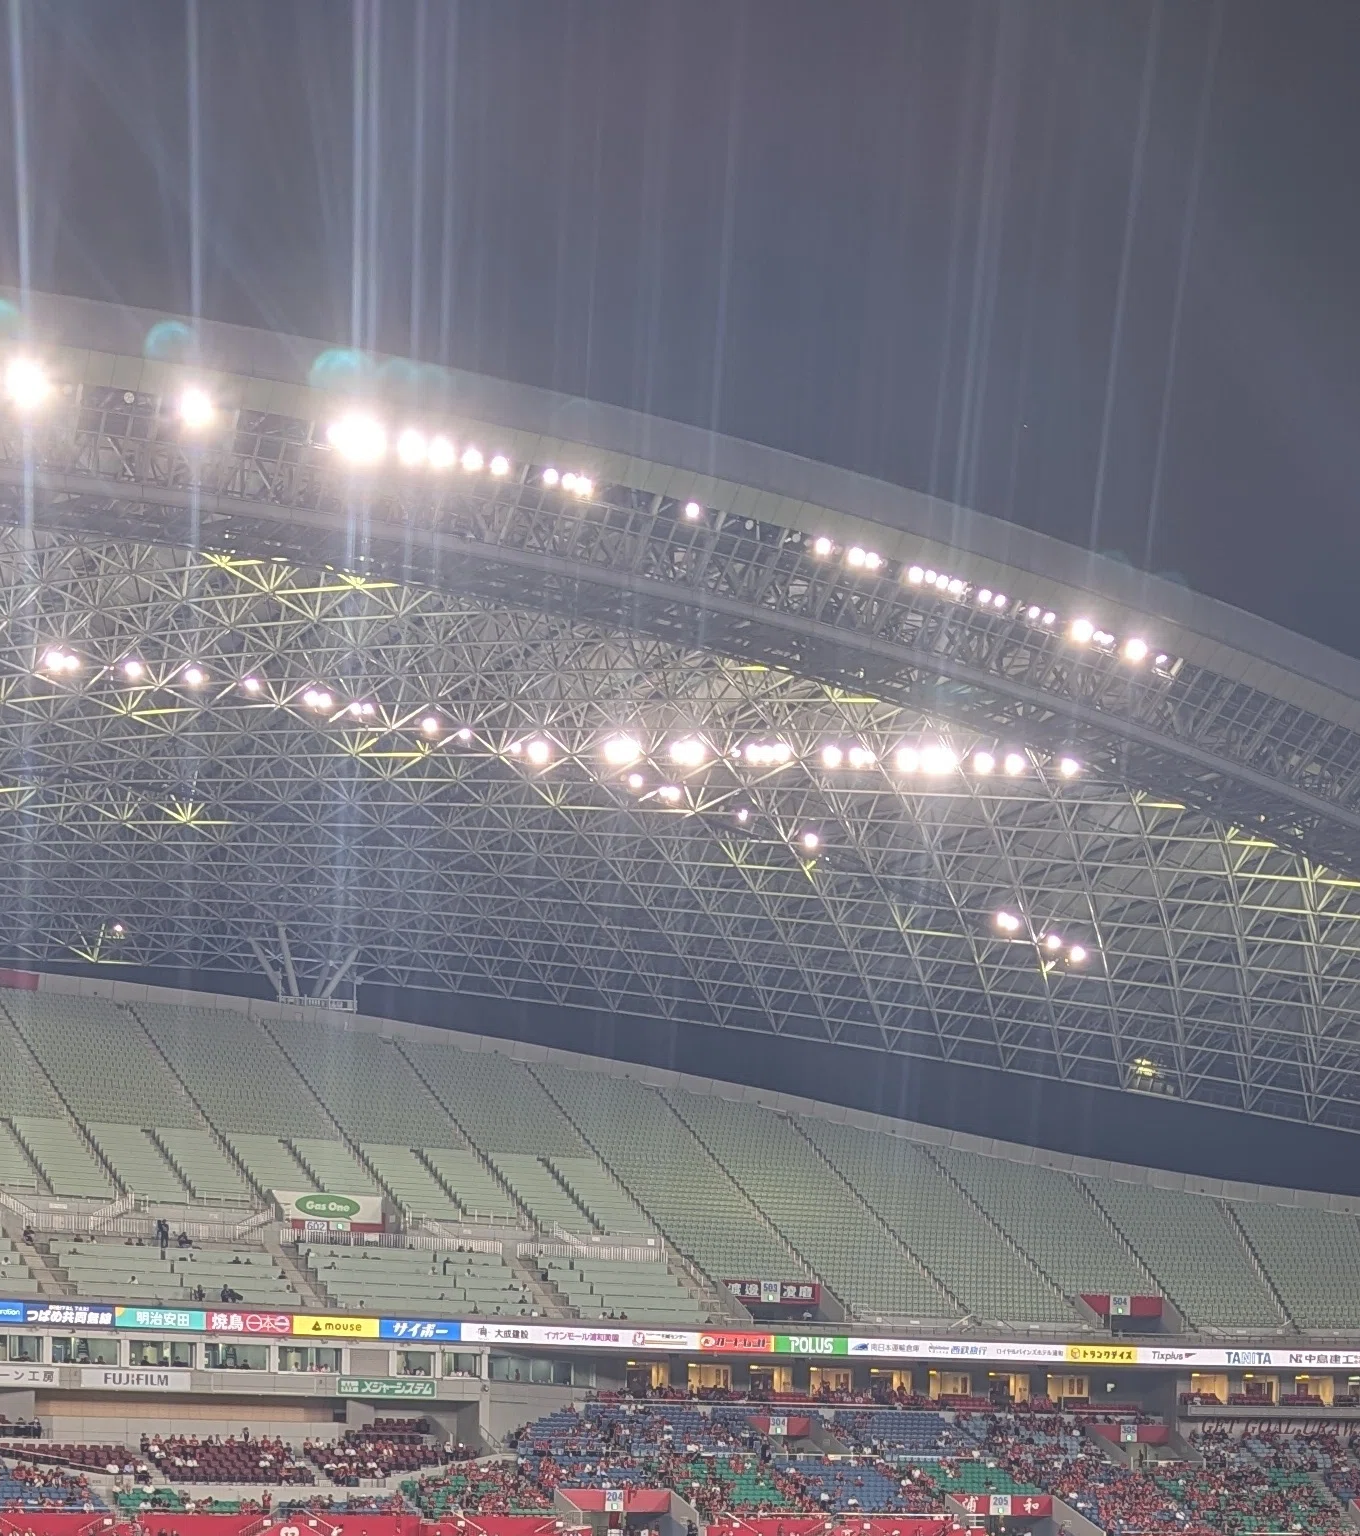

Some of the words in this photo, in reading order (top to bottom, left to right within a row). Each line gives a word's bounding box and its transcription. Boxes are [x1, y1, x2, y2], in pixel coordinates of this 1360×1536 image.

[305, 1200, 327, 1210] Gas
[328, 1202, 351, 1212] One
[136, 1310, 190, 1327] 明治安田
[324, 1322, 363, 1333] mouse
[393, 1322, 449, 1337] サイボー
[789, 1336, 834, 1354] POLUS
[1152, 1350, 1184, 1361] Tixplus
[1225, 1351, 1272, 1365] TANITA
[103, 1372, 170, 1386] FUJIFILM
[361, 1381, 433, 1396] メジャーシステム
[1201, 1418, 1240, 1435] GET
[1244, 1418, 1295, 1436] GOAL
[606, 1491, 623, 1502] 204
[992, 1494, 1010, 1506] 205
[1023, 1496, 1042, 1514] 和
